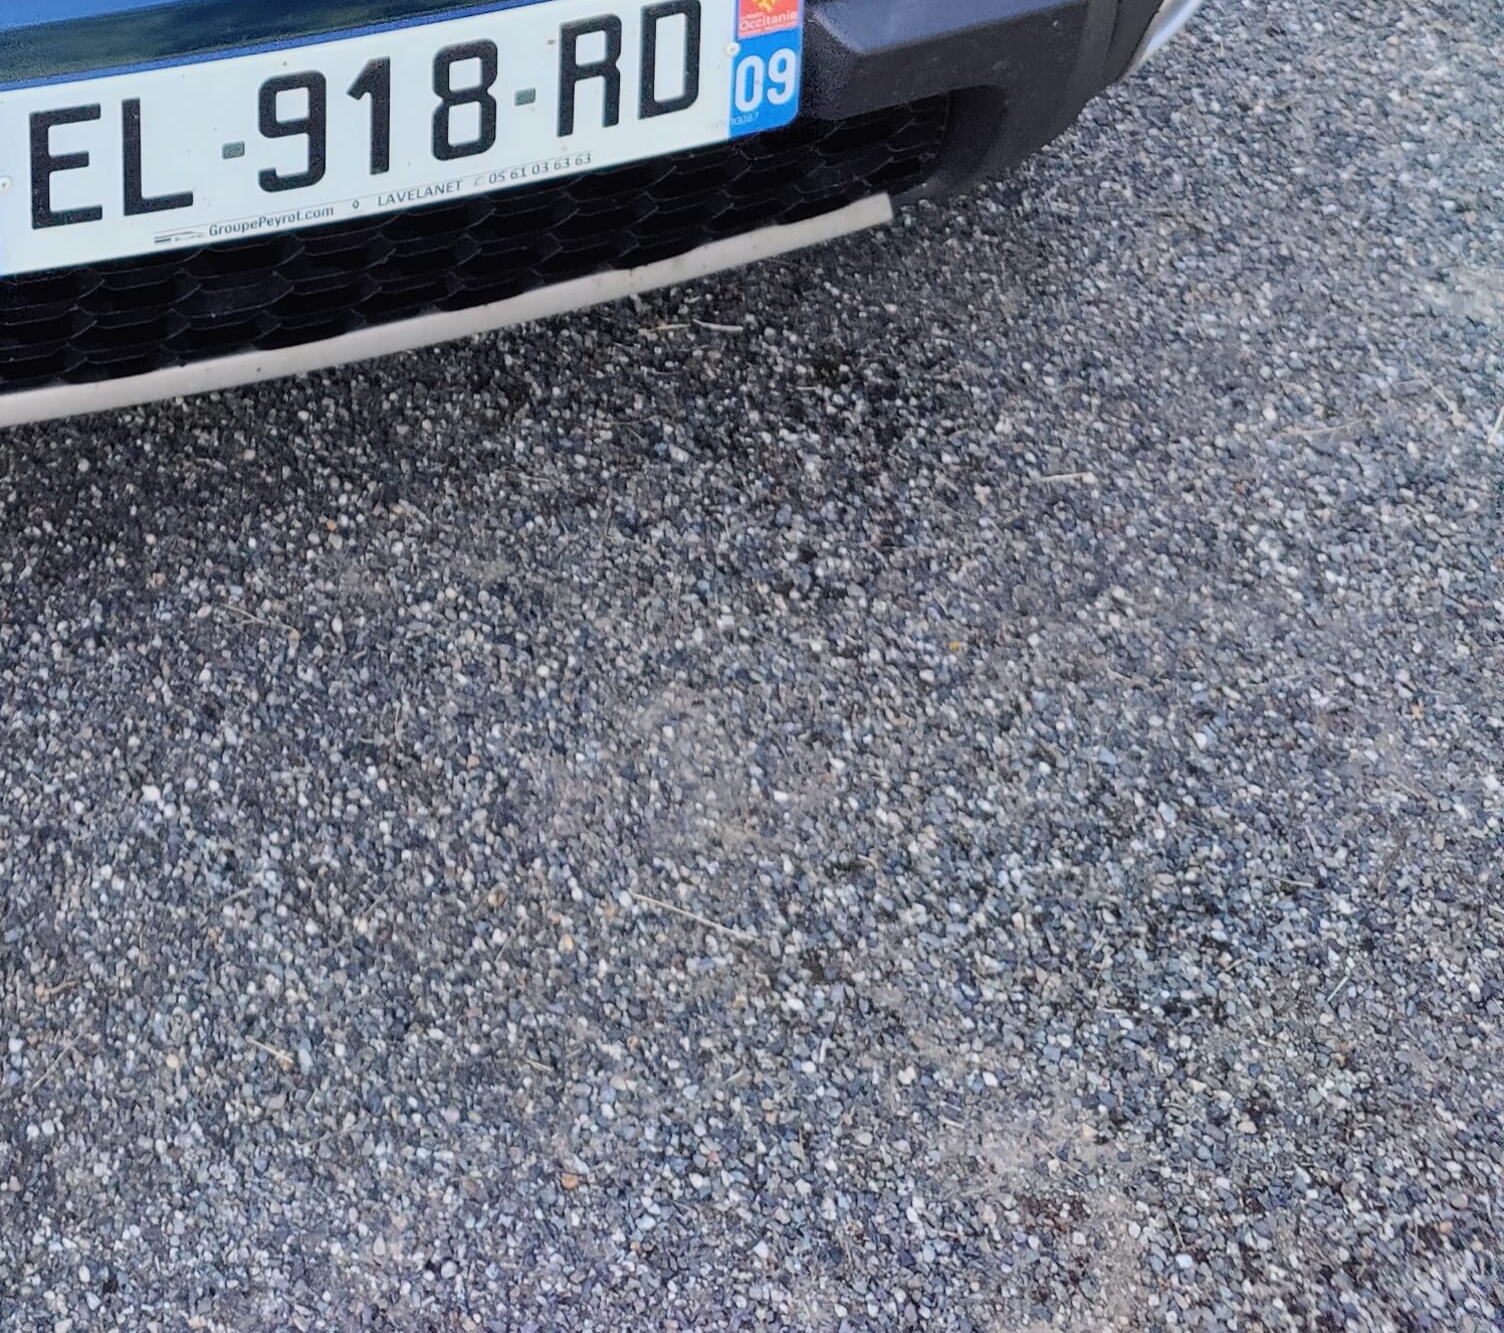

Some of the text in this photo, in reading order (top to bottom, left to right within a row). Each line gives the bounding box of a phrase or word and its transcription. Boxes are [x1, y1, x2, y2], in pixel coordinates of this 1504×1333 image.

[739, 10, 798, 32] Occitanie
[734, 47, 797, 113] 09
[209, 152, 592, 238] GroupePeyrot.com LAVELANET 05 61 03 63 63
